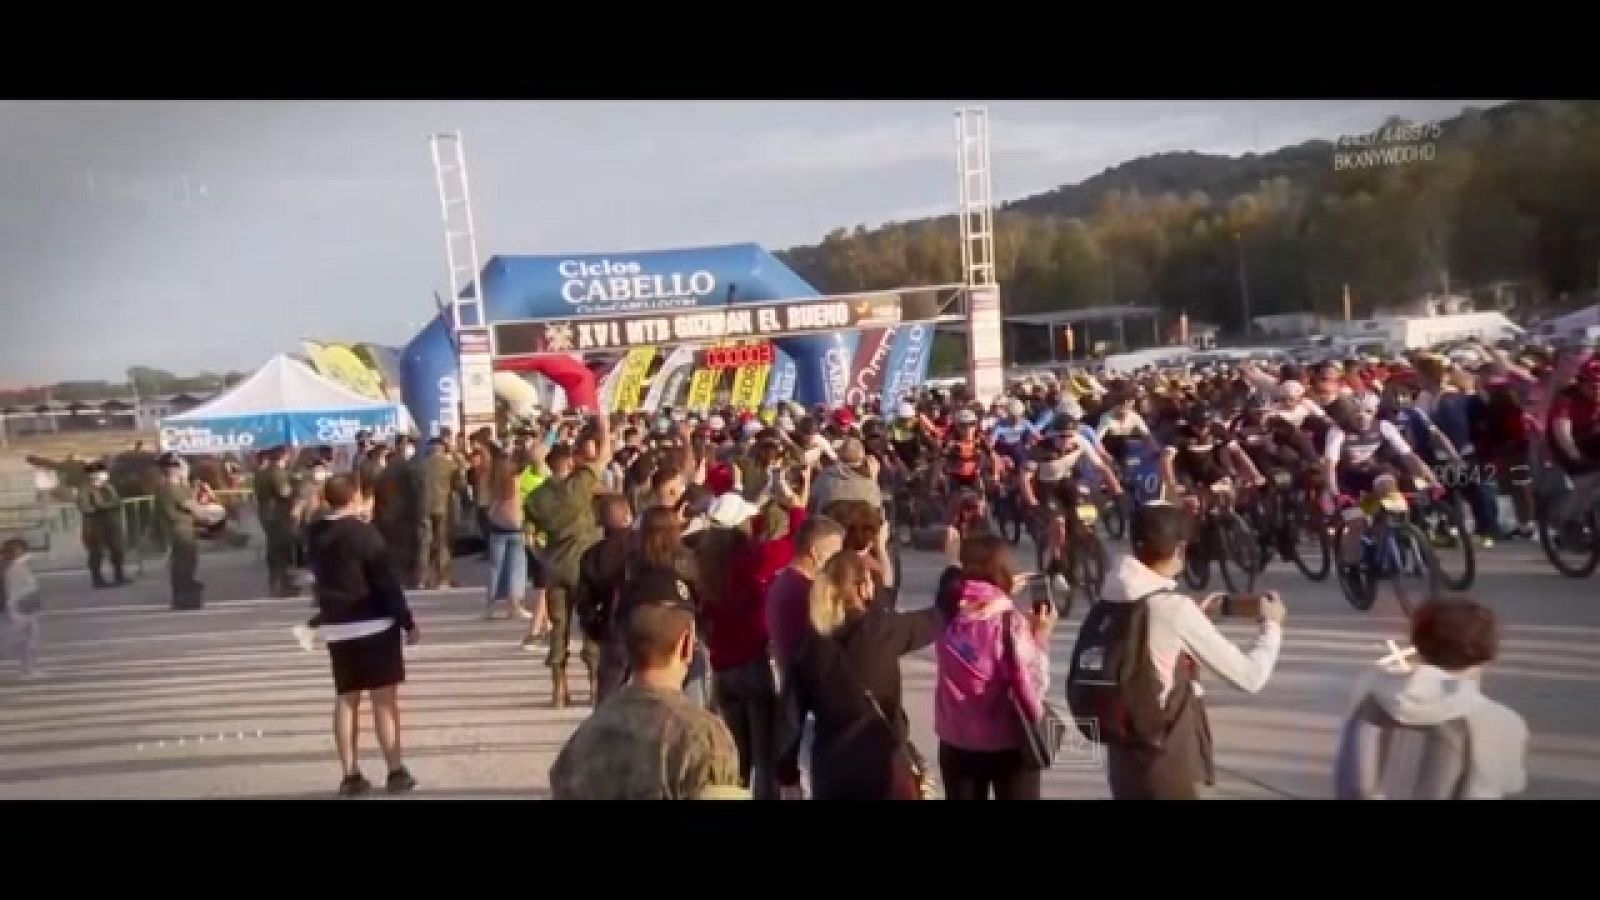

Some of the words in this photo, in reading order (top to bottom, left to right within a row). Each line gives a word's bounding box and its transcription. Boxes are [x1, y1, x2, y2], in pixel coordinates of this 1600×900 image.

[559, 256, 641, 278] Ciclos
[562, 269, 716, 304] CABELLO
[578, 321, 620, 349] XVI
[758, 307, 781, 332] EL
